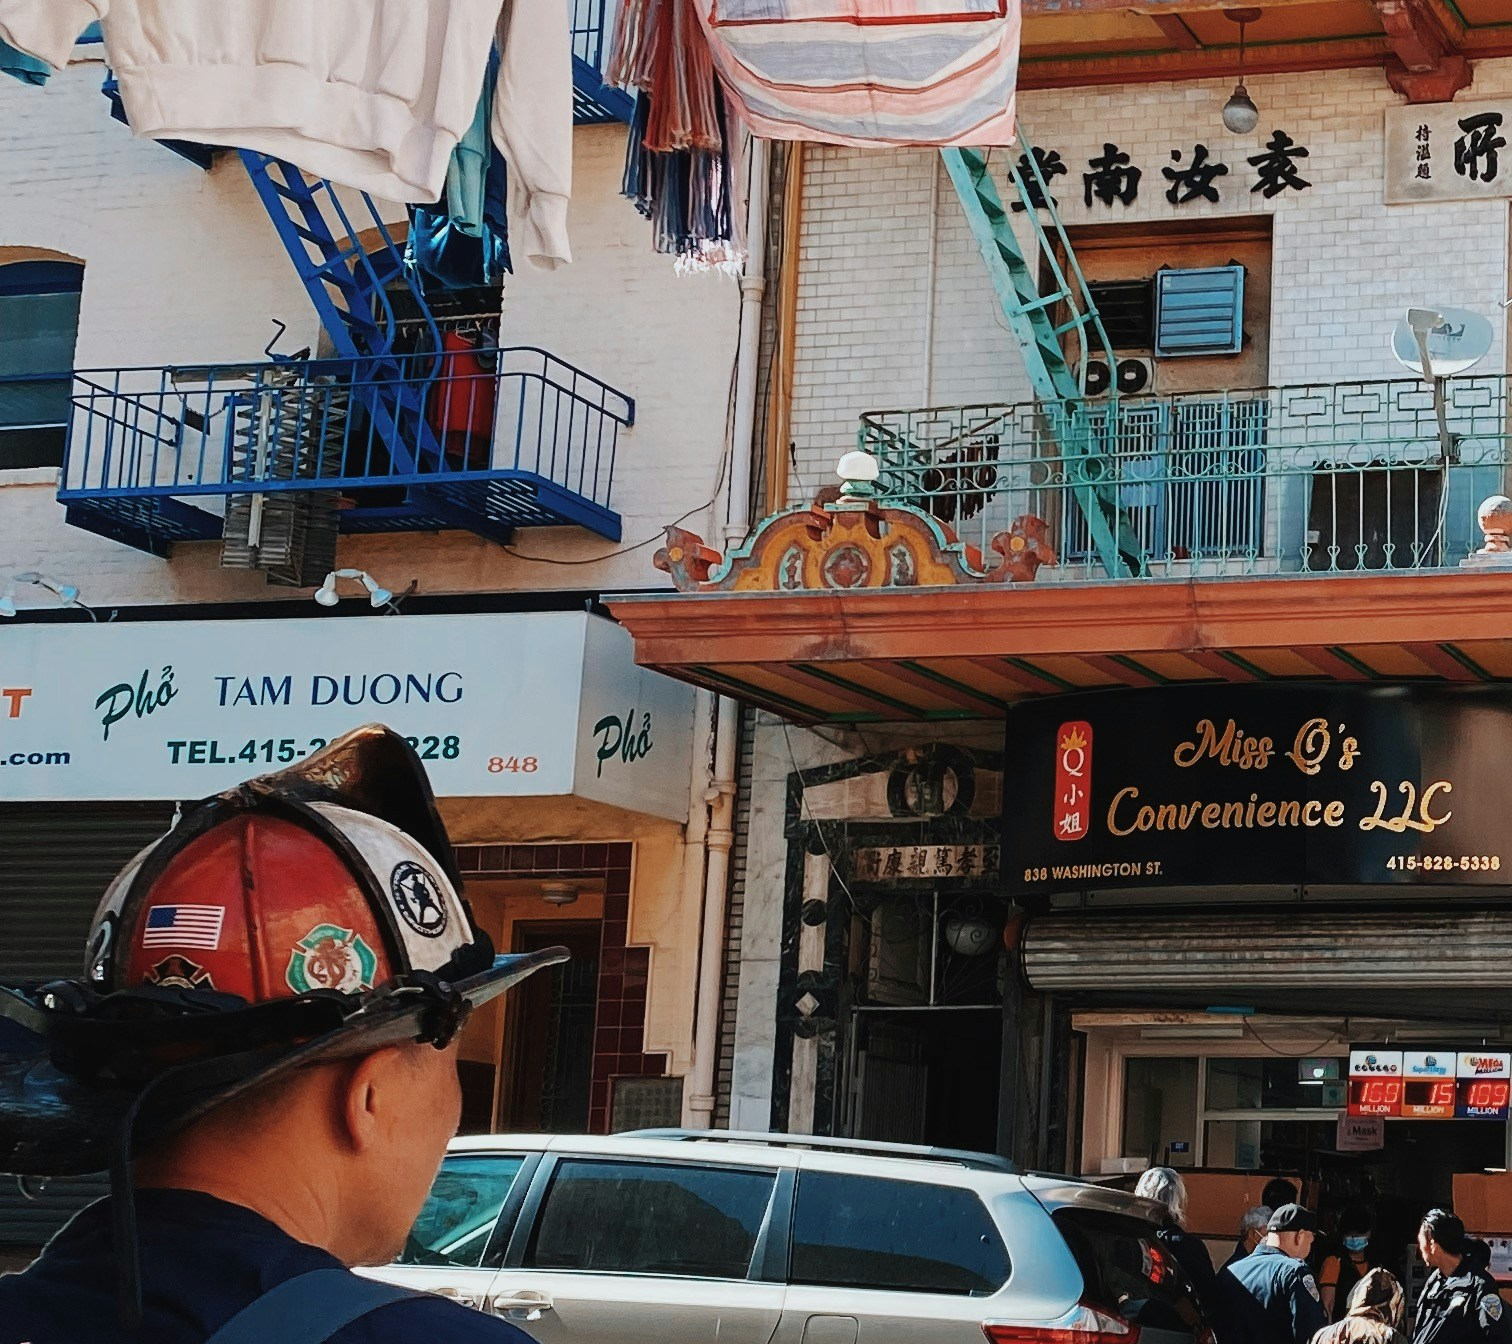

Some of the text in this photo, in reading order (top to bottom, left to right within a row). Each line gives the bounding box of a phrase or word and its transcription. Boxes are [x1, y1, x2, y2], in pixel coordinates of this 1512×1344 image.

[214, 675, 292, 706] TAM
[311, 671, 463, 705] DUONG
[1174, 718, 1361, 775] Miss Q's
[488, 756, 538, 773] 848
[1107, 779, 1453, 837] Convenience LLC
[1051, 862, 1141, 880] WASHINGTON
[1145, 861, 1164, 876] ST.
[1430, 1083, 1453, 1104] 15
[1359, 1105, 1391, 1113] MILLION
[1467, 1107, 1499, 1115] MILLION
